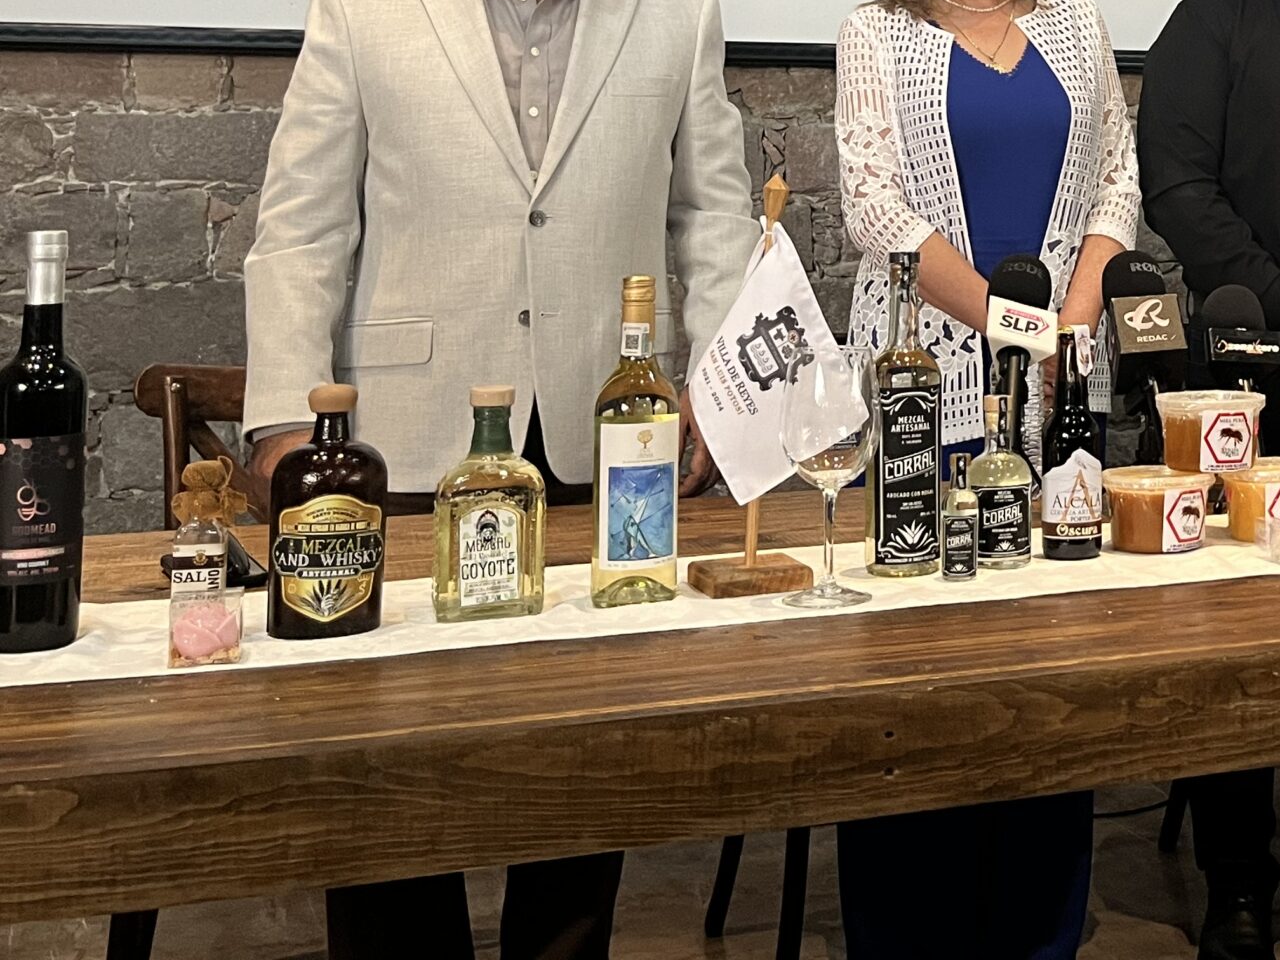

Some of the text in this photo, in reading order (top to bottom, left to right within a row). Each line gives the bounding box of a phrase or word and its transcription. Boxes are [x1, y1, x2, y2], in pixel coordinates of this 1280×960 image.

[1000, 314, 1039, 333] SLP
[716, 336, 759, 416] VILLA DE REYES
[890, 422, 931, 433] ARTESANAL
[897, 414, 925, 424] MEZCAL
[884, 450, 936, 480] CORRAL
[983, 504, 1022, 526] CORRAL
[1056, 523, 1098, 536] Oscura
[302, 537, 365, 554] MEZCAL
[279, 549, 378, 567] AND WHISKY
[172, 570, 207, 583] SAL
[461, 558, 515, 581] COYOTE
